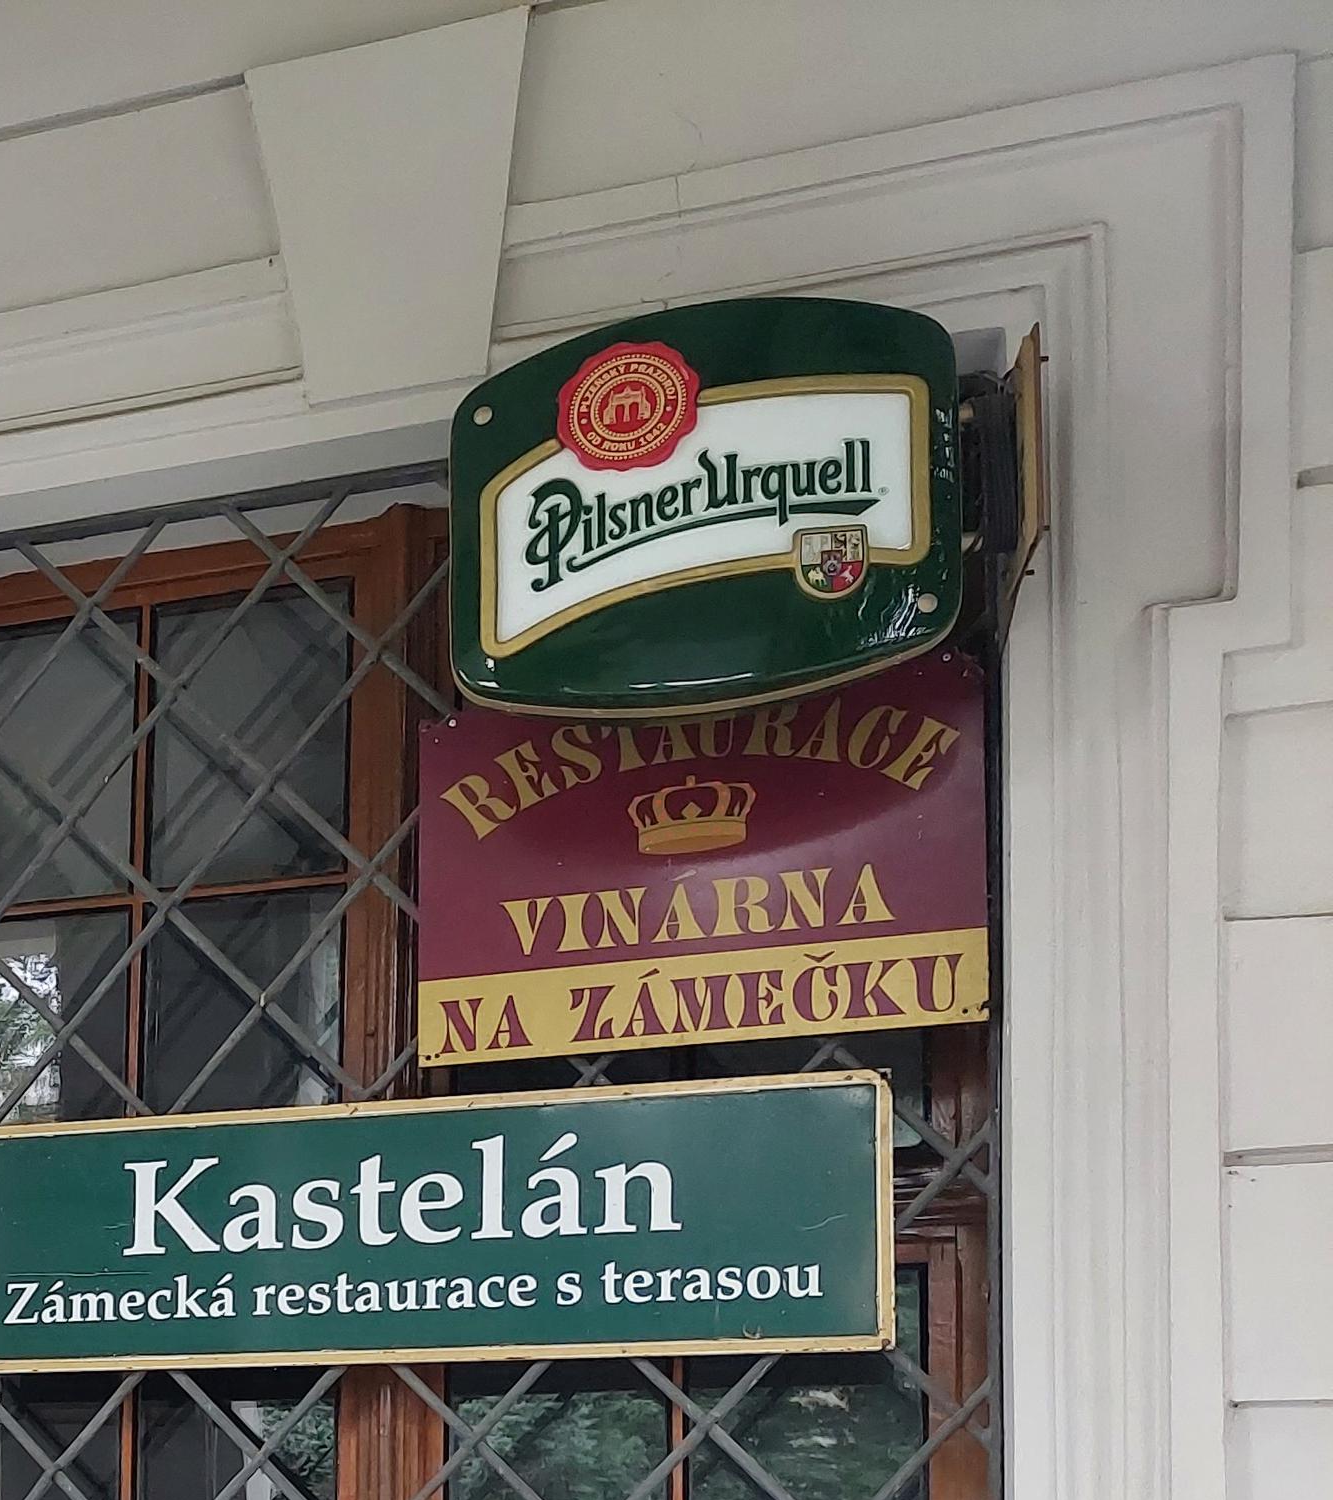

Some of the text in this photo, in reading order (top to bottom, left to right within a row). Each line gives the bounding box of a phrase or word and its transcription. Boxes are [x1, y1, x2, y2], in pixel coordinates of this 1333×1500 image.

[629, 363, 677, 401] PRAZDROJ
[586, 422, 668, 452] OD ROKU 1842
[524, 437, 874, 593] Pilsner Urquell
[439, 697, 962, 842] RESTAURACE
[499, 862, 897, 957] VINÁRNA
[438, 950, 966, 1055] NA ZÁMEČKU
[122, 1130, 684, 1257] Kastelán
[2, 1259, 825, 1326] Zámecká restaurace s terasou
